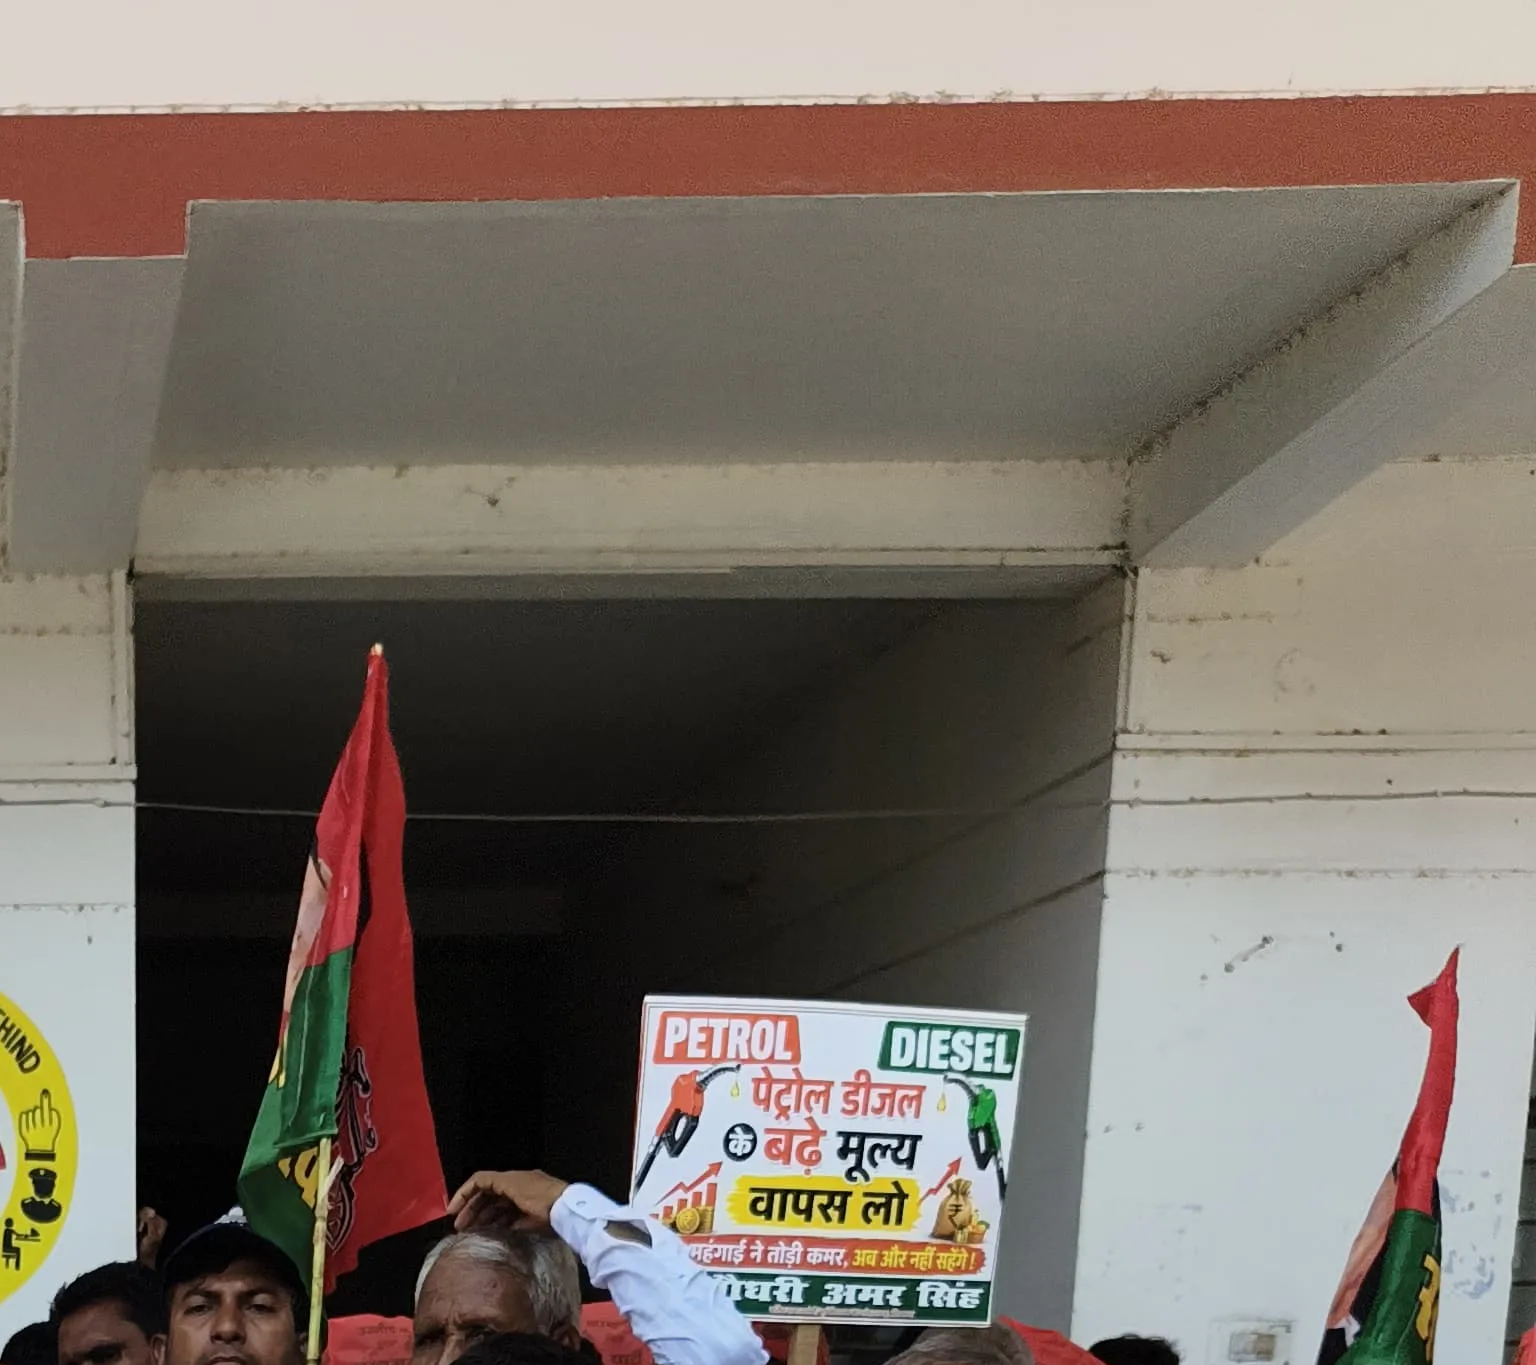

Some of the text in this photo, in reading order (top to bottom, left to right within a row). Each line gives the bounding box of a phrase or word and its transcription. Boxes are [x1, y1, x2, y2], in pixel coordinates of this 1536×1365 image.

[664, 1016, 793, 1060] PETROL
[890, 1027, 1013, 1074] DIESEL
[751, 1066, 927, 1121] पेट्रोल डीजल
[728, 1116, 923, 1183] के बढ़े मूल्य
[749, 1180, 909, 1226] वापस लो
[689, 1238, 747, 1265] महंगाई
[749, 1240, 764, 1263] ने
[767, 1241, 803, 1269] तोड़ी
[806, 1246, 848, 1269] कमर,
[852, 1248, 879, 1267] अब
[879, 1243, 907, 1268] और
[910, 1245, 936, 1271] नहीं
[821, 1281, 907, 1307] अमर
[916, 1281, 984, 1309] सिंह
